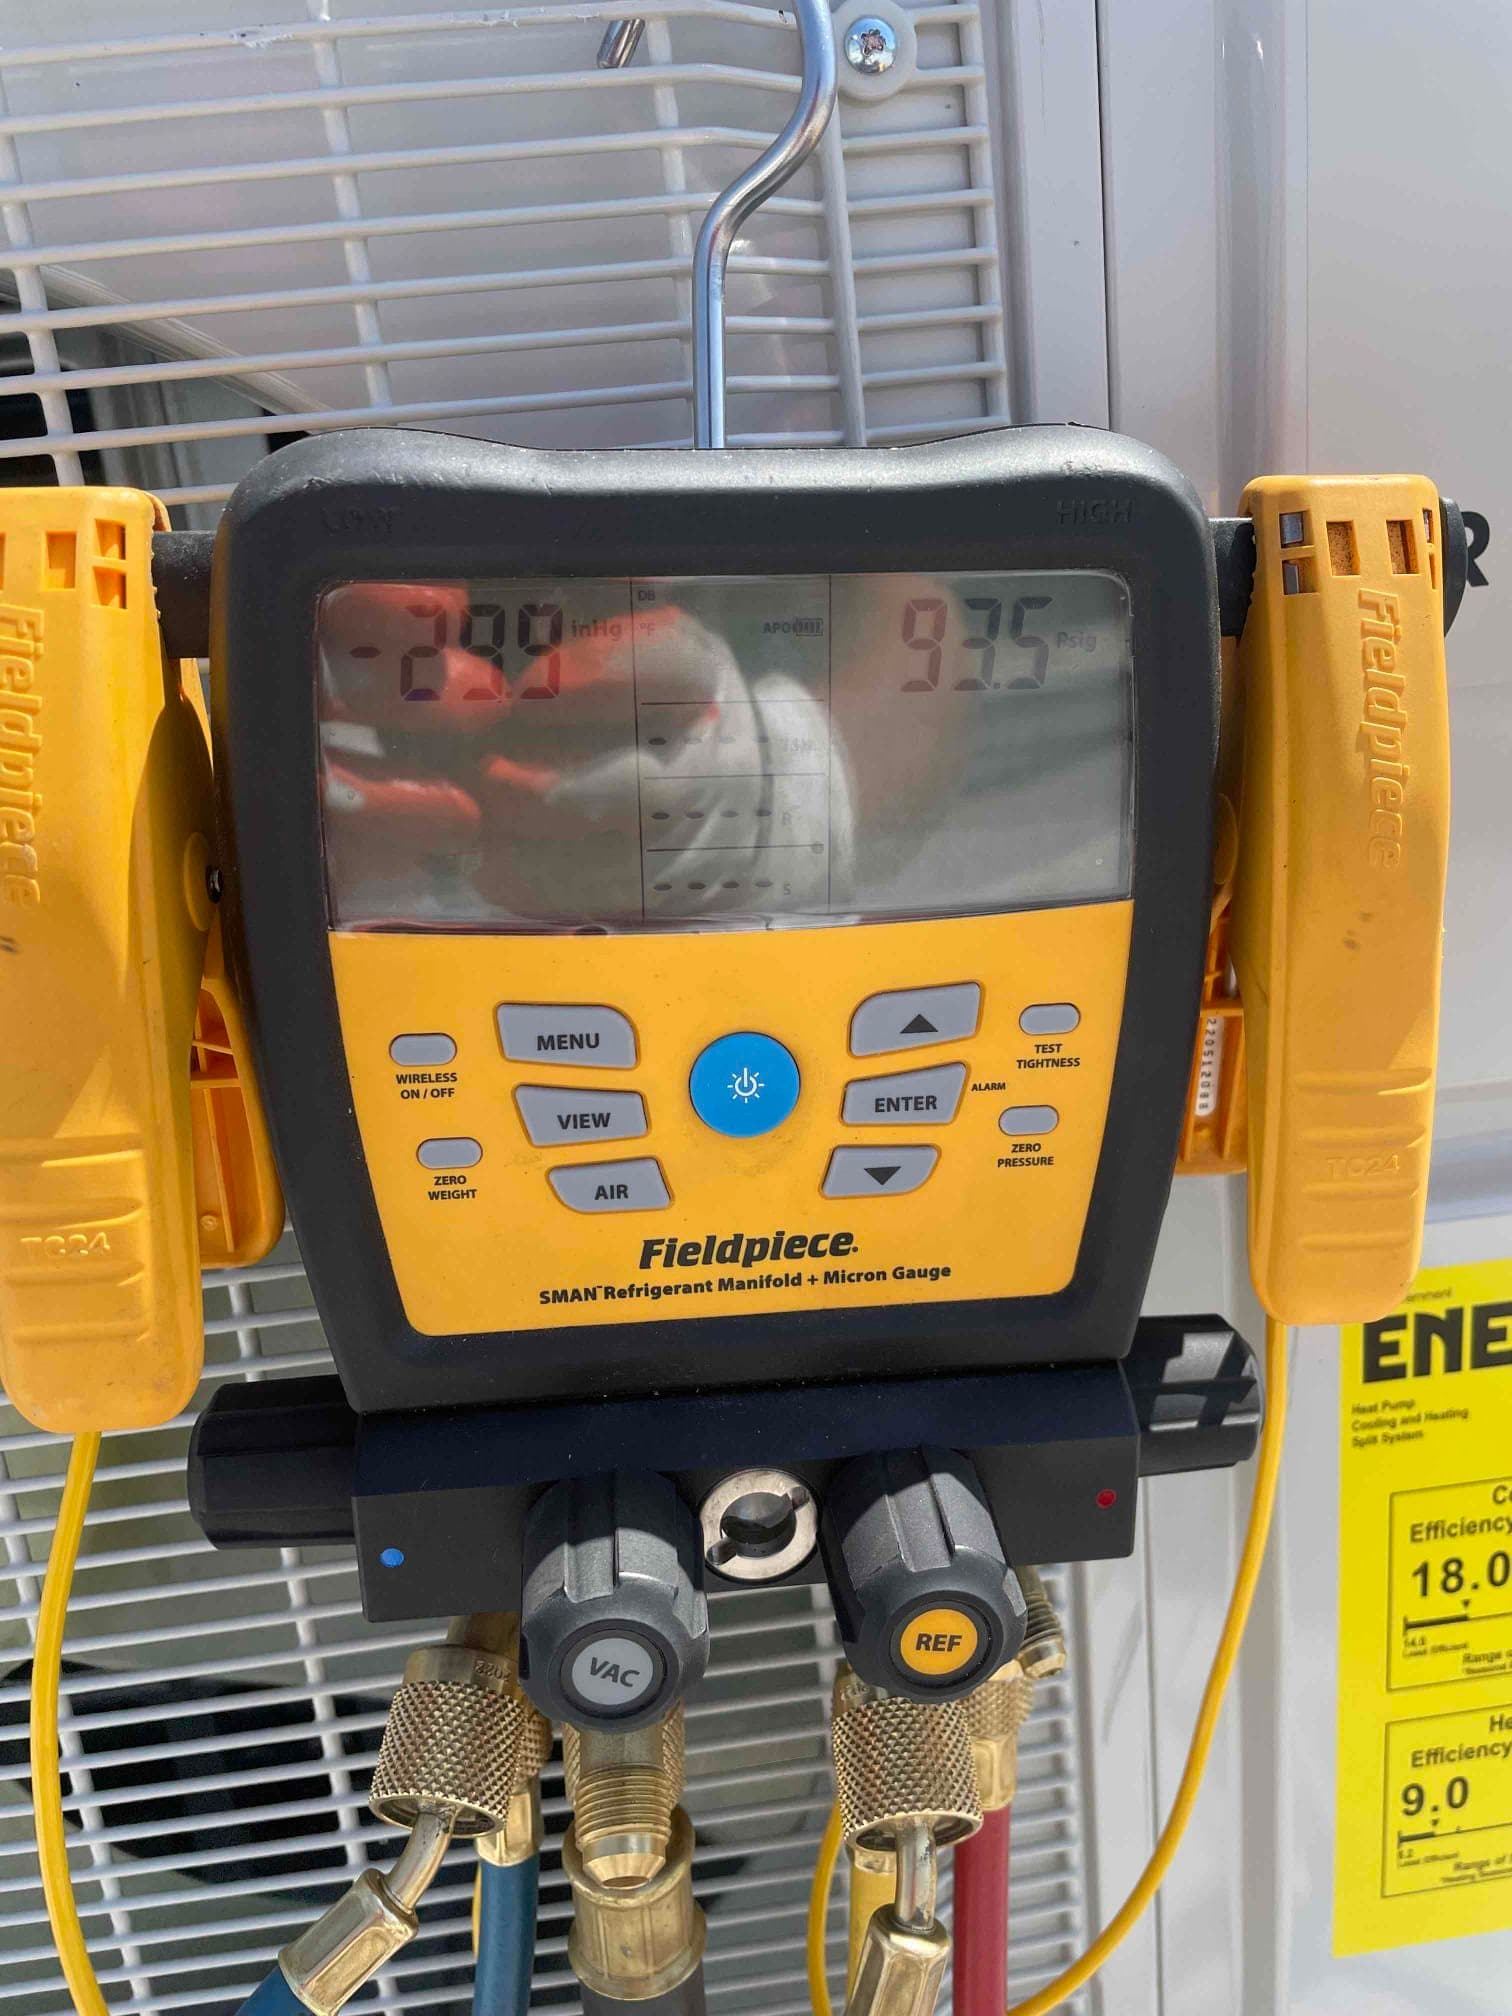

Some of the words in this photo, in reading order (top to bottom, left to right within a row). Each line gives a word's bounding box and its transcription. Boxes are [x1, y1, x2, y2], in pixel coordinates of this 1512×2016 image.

[1057, 499, 1132, 525] HIGH
[572, 618, 622, 642] inHg
[900, 596, 1053, 692] 93.5
[1057, 631, 1097, 651] Psig
[1357, 586, 1411, 872] Fieldpiece
[536, 1032, 601, 1051] MENU
[1034, 1043, 1063, 1054] TEST
[1016, 1056, 1081, 1069] TIGHTNESS
[396, 1072, 458, 1084] WIRELESS
[971, 1082, 1006, 1092] ALARM
[400, 1089, 420, 1100] ON
[430, 1088, 455, 1099] OFF
[874, 1094, 938, 1113] ENTER
[556, 1112, 612, 1130] VIEW
[1011, 1142, 1042, 1154] ZERO
[997, 1156, 1055, 1168] PRESSURE
[433, 1175, 467, 1186] ZERO
[427, 1188, 477, 1201] WEIGHT
[594, 1183, 629, 1201] AIR
[603, 1279, 713, 1301] Refrigerant
[717, 1272, 802, 1293] Manifold
[806, 1275, 819, 1287] +
[823, 1266, 888, 1285] Micron
[892, 1263, 952, 1283] Gauge
[1351, 1417, 1397, 1432] Cooling
[1425, 1408, 1469, 1422] Heating
[1412, 1550, 1511, 1598] 18.0
[915, 1632, 962, 1653] REF
[588, 1655, 640, 1689] VAC
[1402, 1775, 1469, 1817] 9.0
